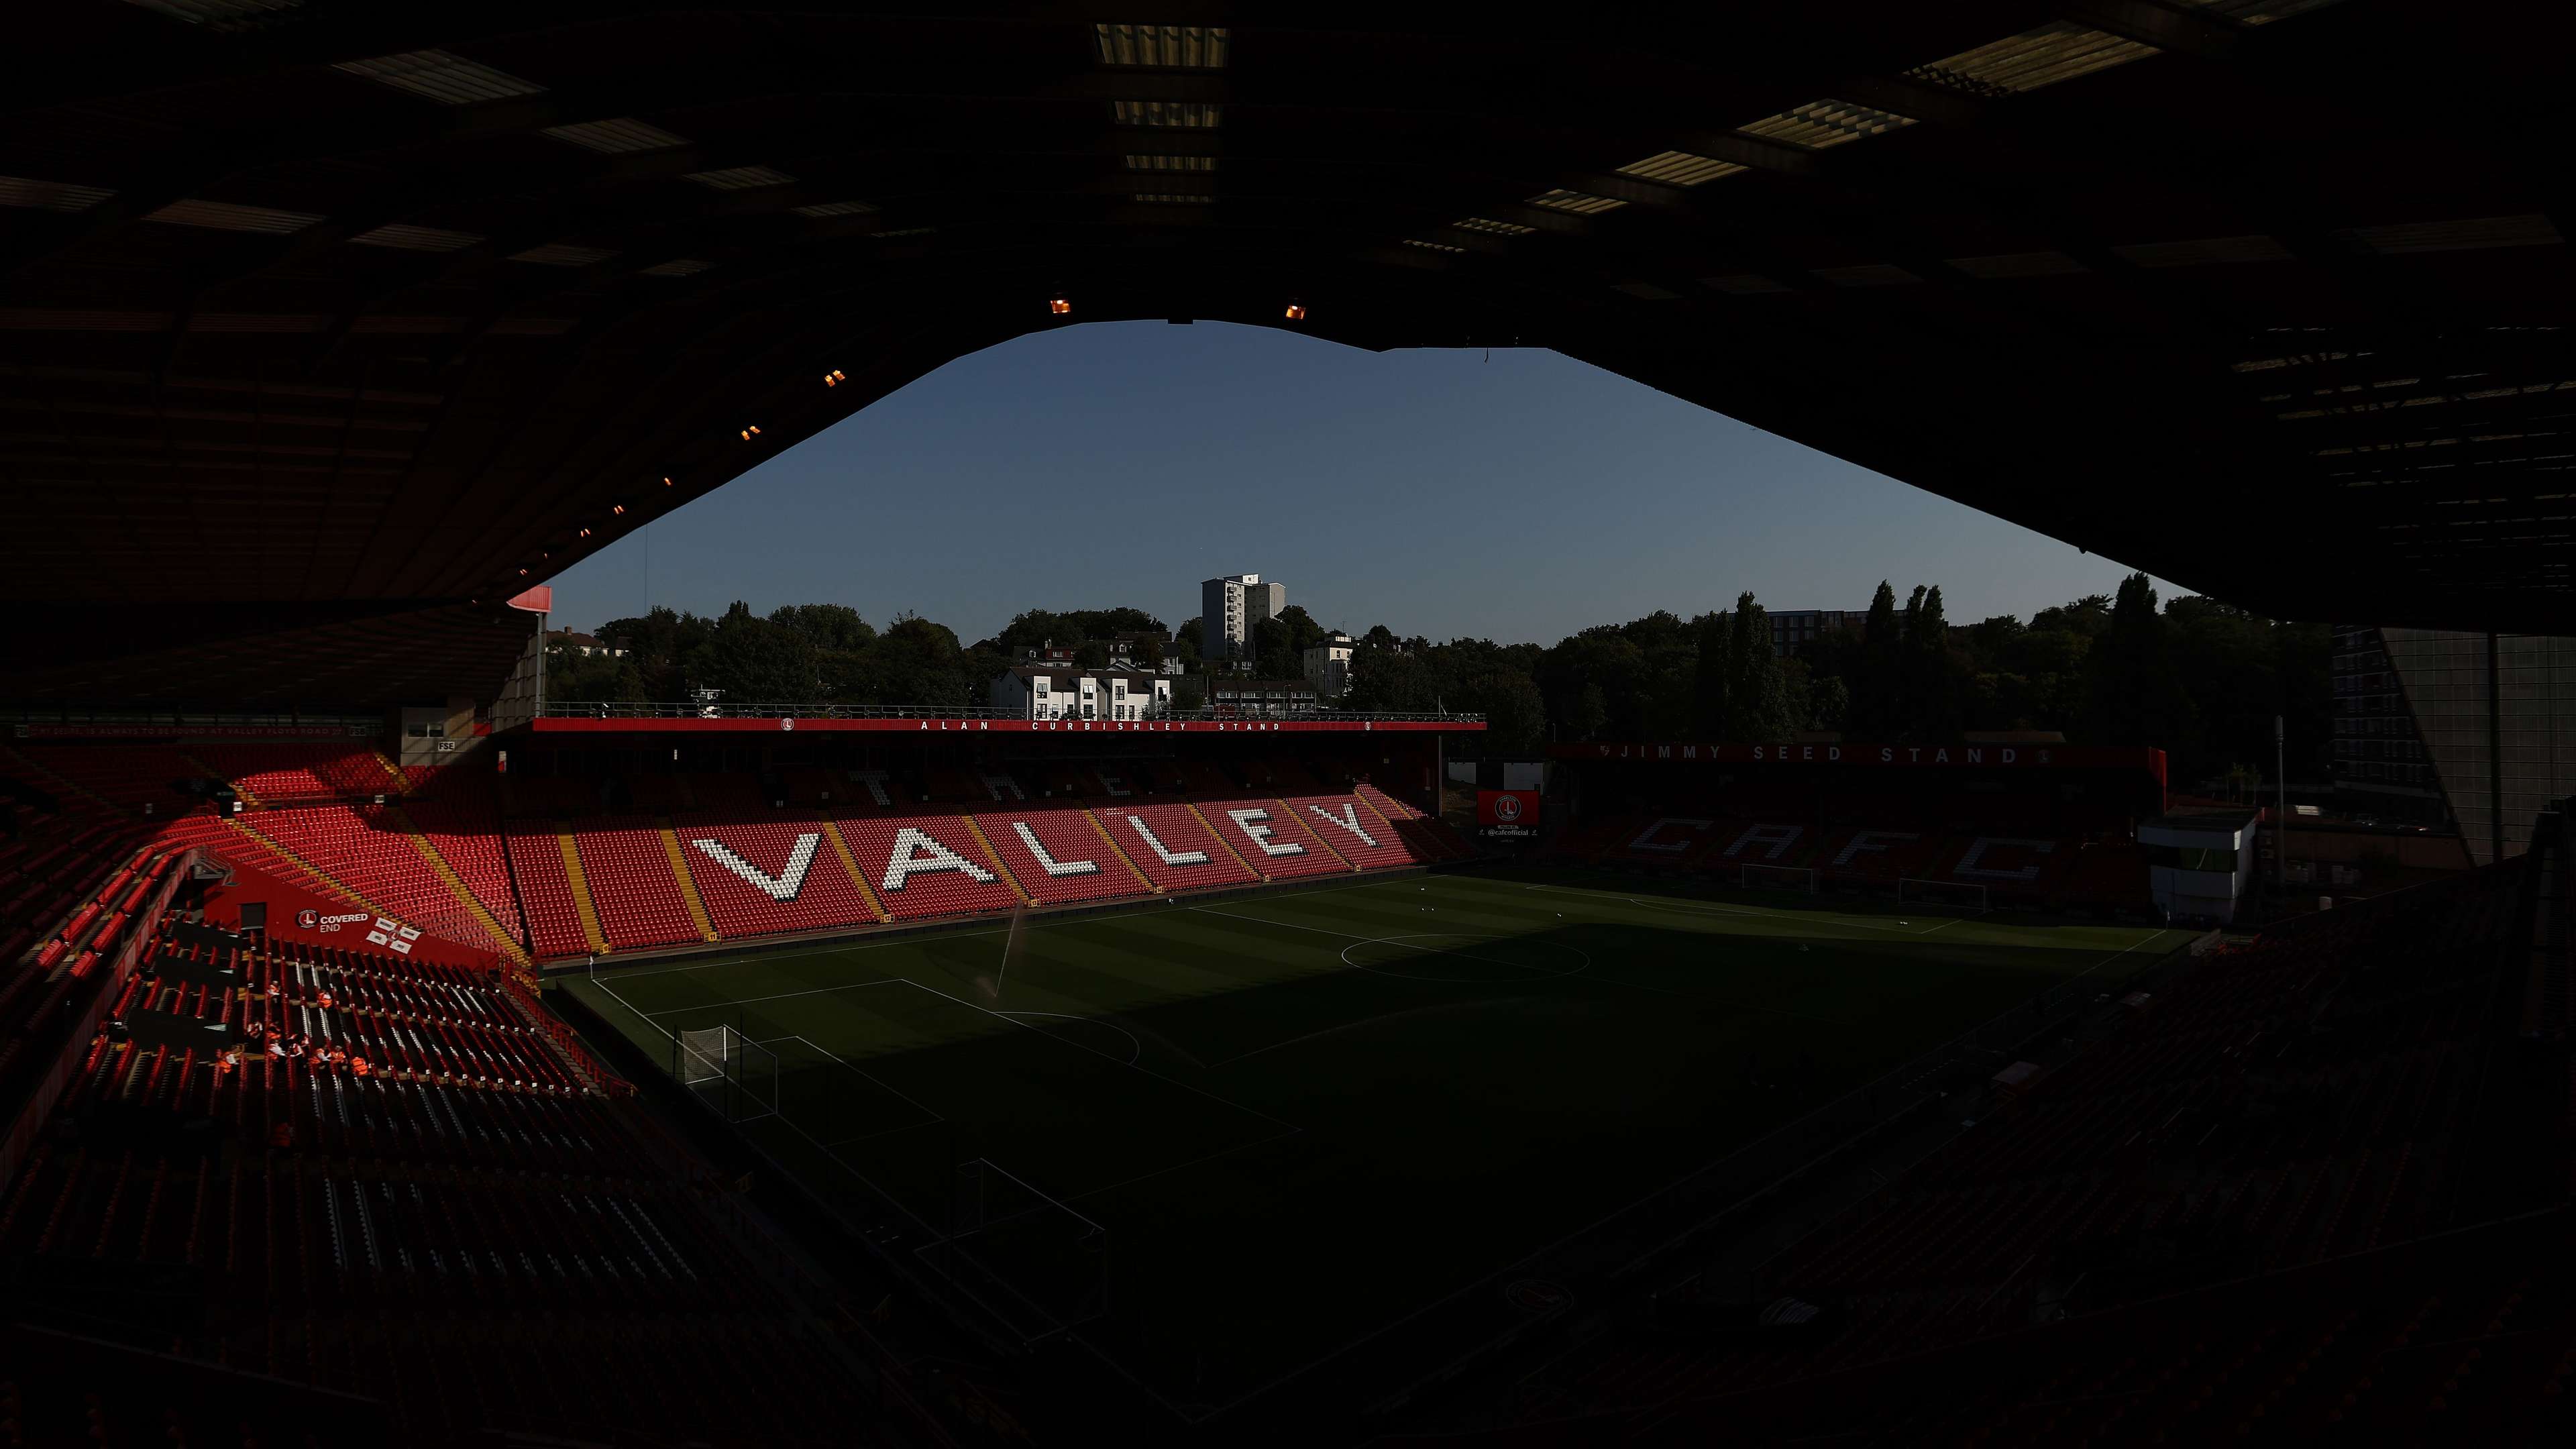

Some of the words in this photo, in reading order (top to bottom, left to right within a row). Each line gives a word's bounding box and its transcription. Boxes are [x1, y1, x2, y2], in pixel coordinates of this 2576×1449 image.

[921, 721, 987, 730] ALAN
[1032, 722, 1185, 731] CURBISHLEY
[1219, 722, 1279, 731] STAND
[1621, 745, 1720, 759] JIMMY
[1753, 746, 1841, 761] SEED
[1880, 747, 2017, 763] STAND
[692, 803, 1380, 900] VALLEY
[1628, 817, 2056, 881] CAFC
[320, 913, 369, 924] COVERED
[320, 924, 341, 933] END
